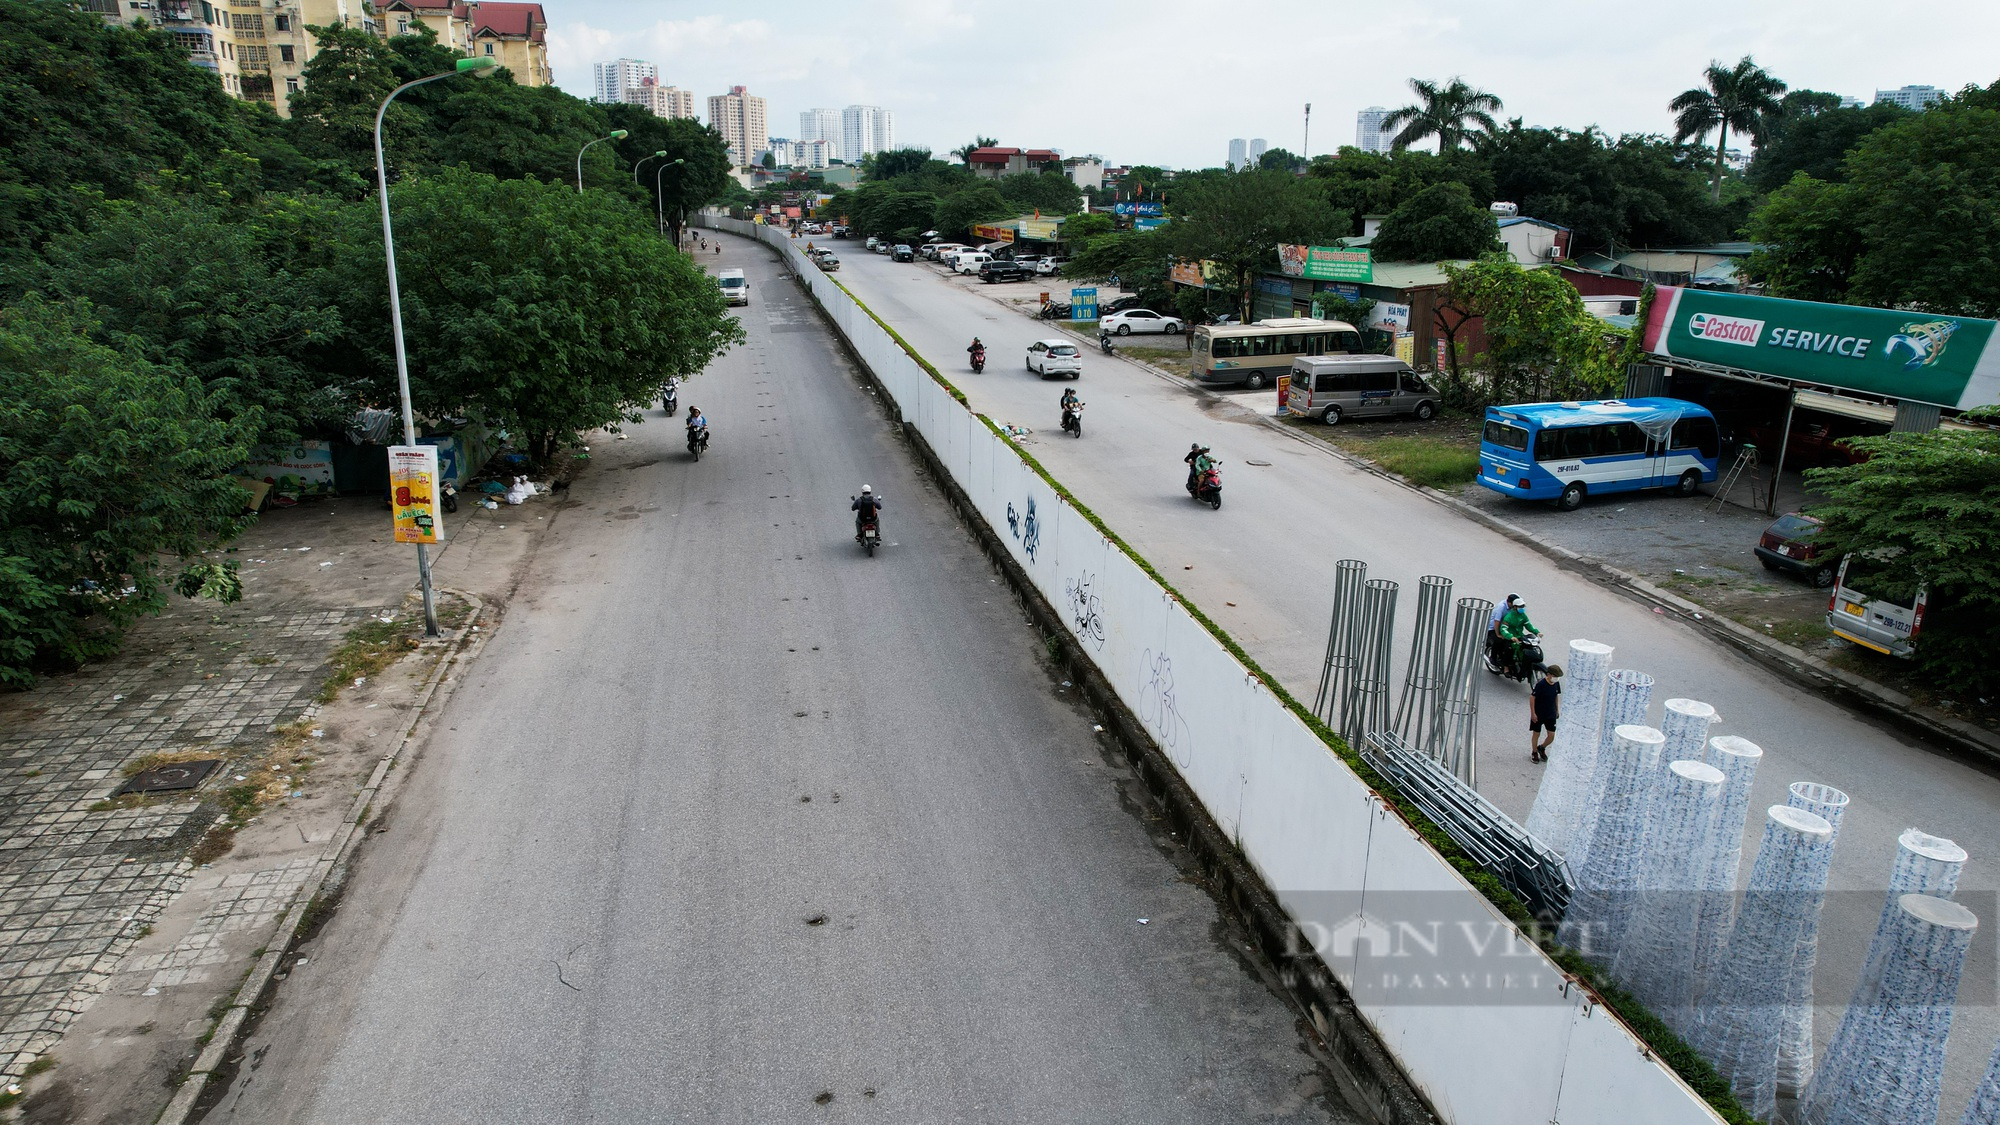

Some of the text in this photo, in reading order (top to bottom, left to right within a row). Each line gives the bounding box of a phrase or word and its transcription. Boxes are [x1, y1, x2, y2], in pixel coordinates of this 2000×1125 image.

[1073, 292, 1097, 308] NỘI THẤT
[1077, 308, 1092, 319] Ô TÔ
[1704, 316, 1872, 360] Castrol SERVICE
[396, 486, 411, 507] 8
